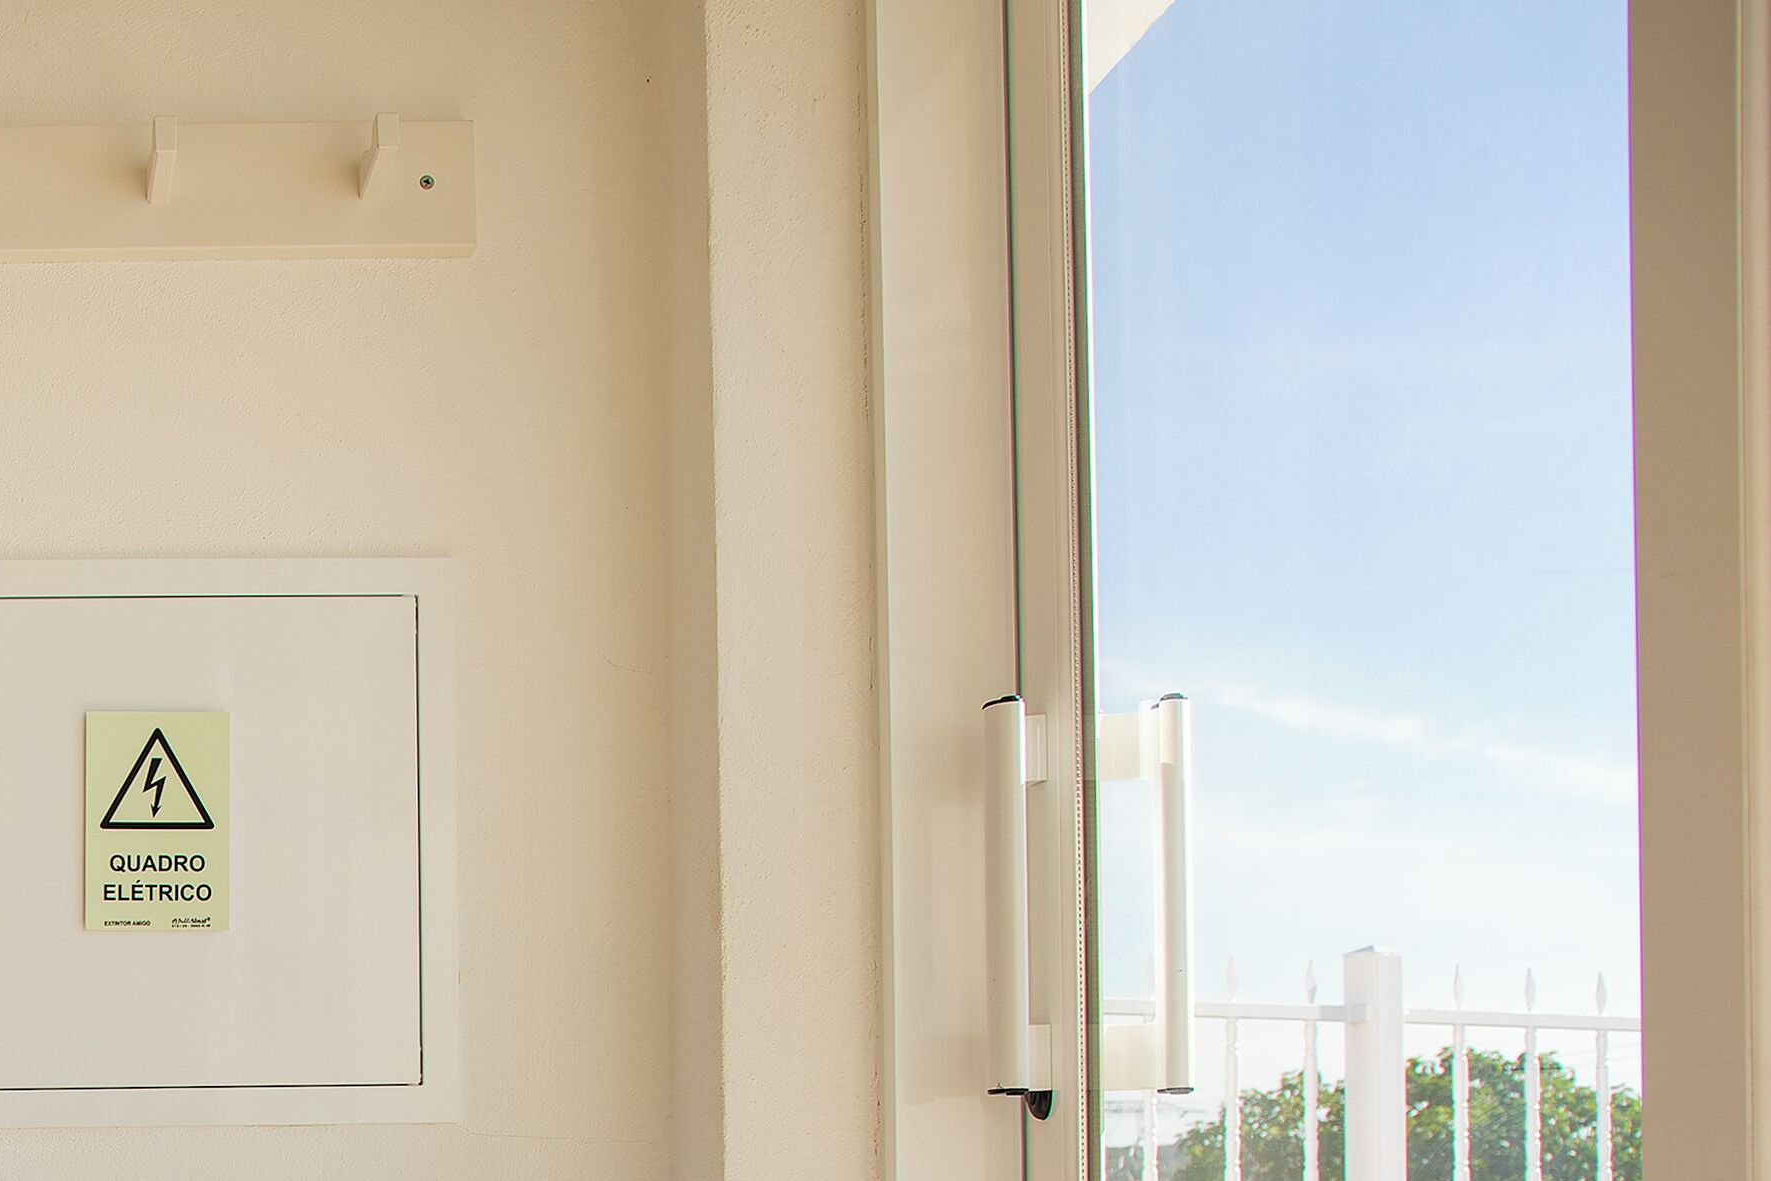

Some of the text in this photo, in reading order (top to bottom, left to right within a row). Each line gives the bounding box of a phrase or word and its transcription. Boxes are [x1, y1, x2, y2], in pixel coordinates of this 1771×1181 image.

[109, 854, 206, 873] QUADRO
[103, 880, 213, 901] ELÉTRICO
[104, 919, 151, 927] EXTINTOR AMIGO
